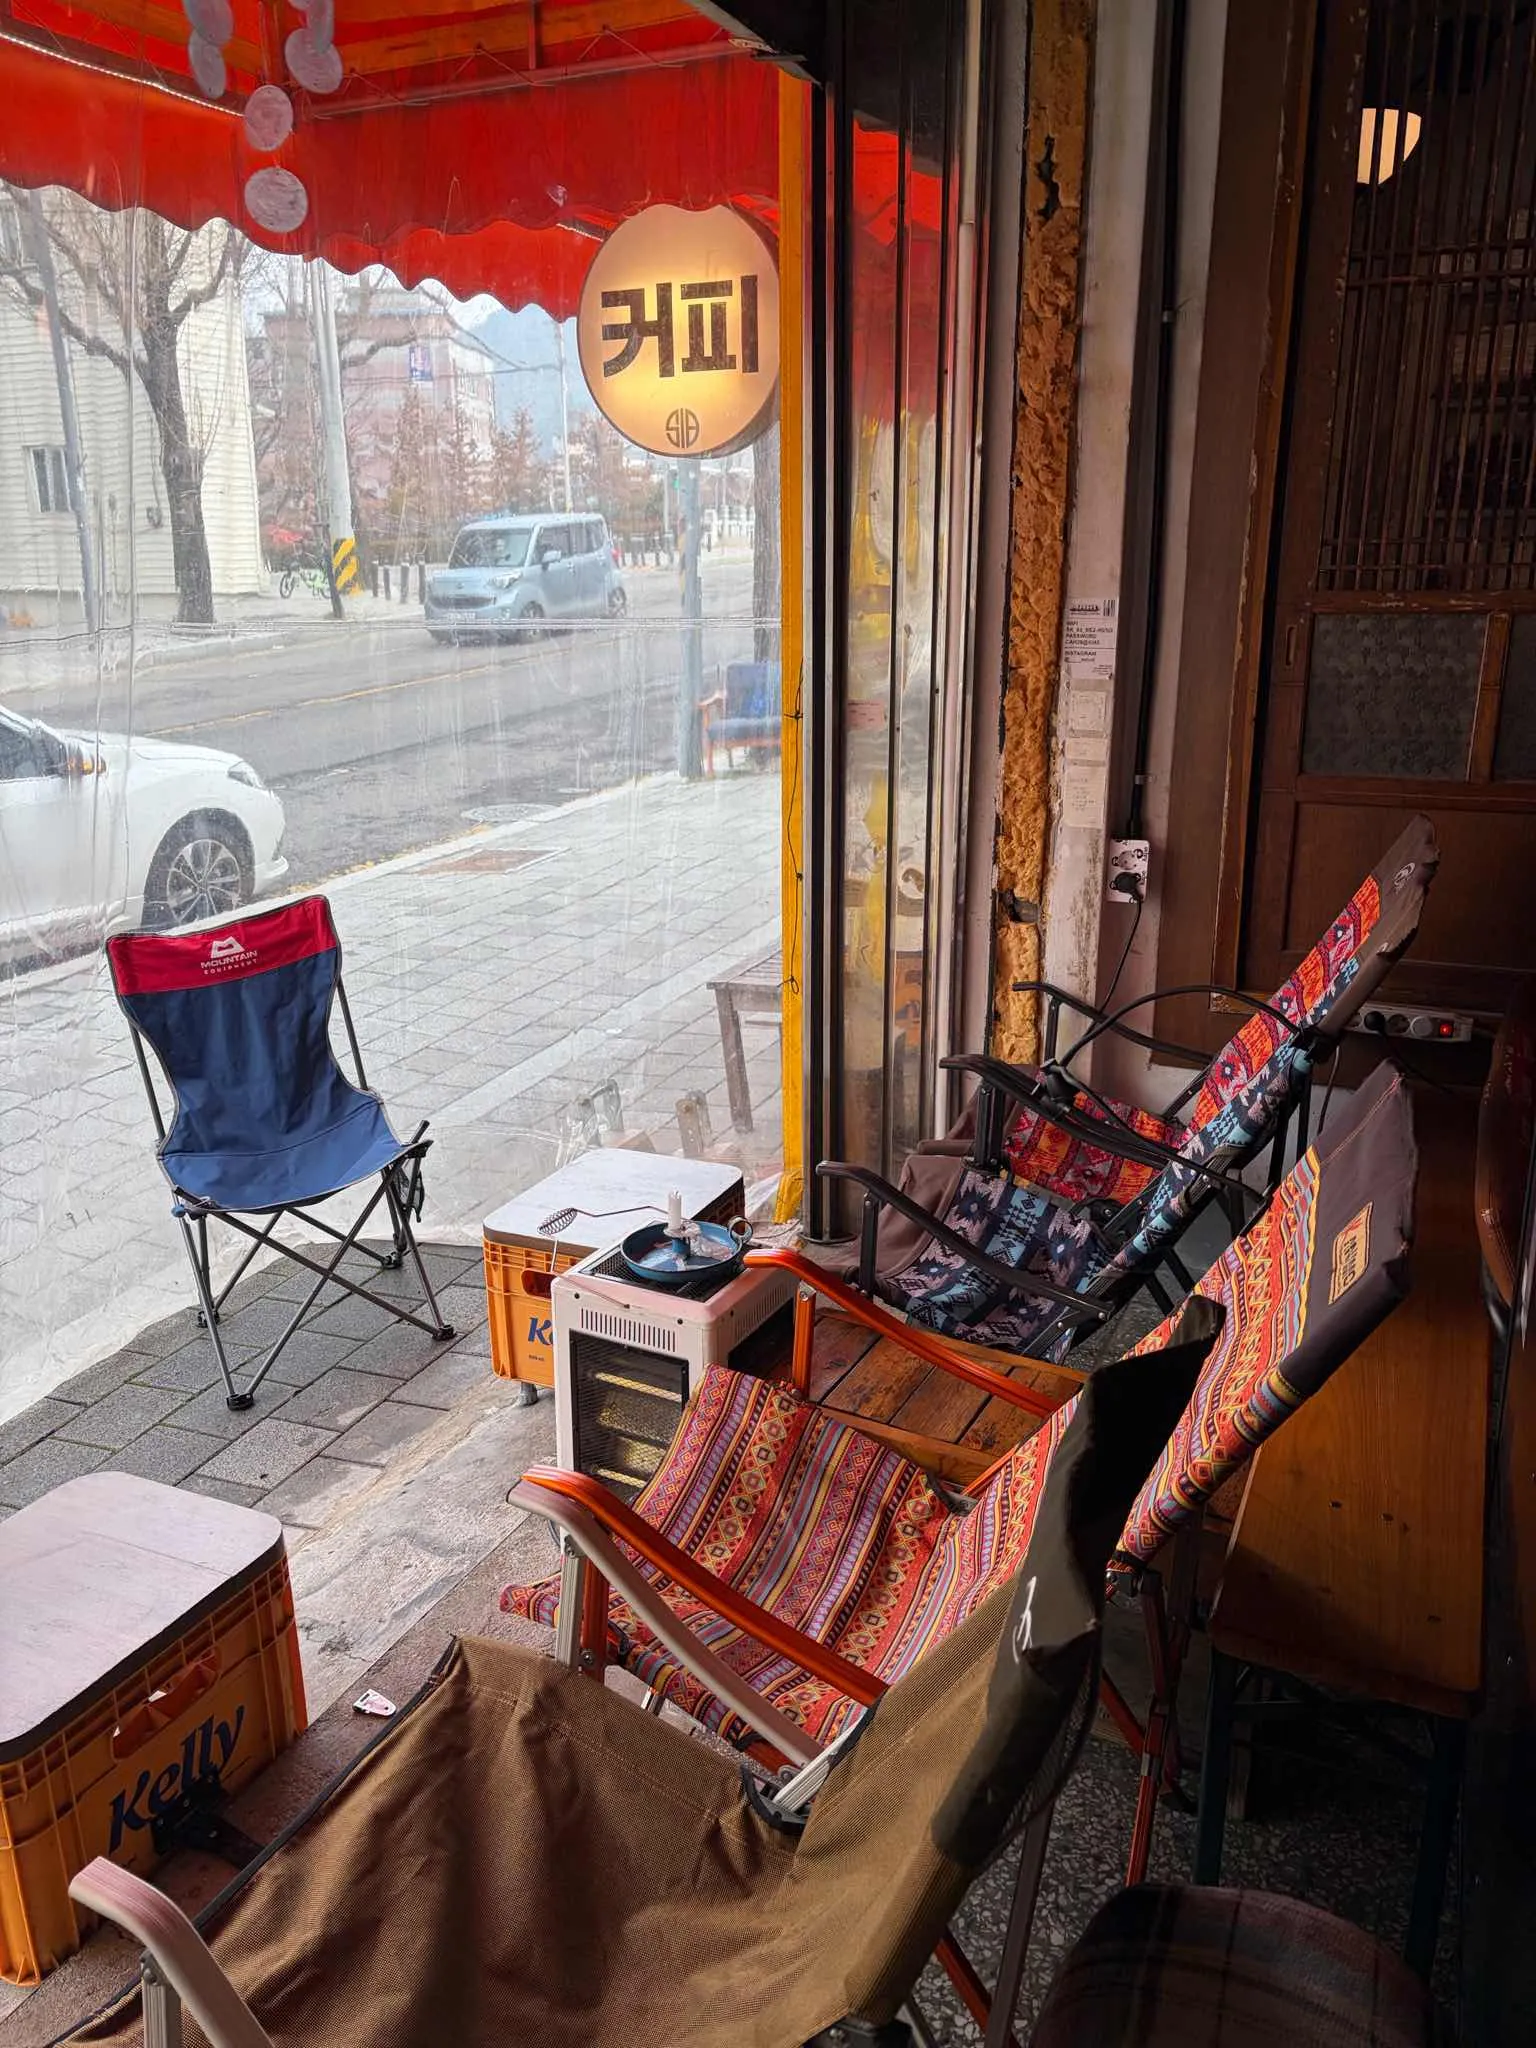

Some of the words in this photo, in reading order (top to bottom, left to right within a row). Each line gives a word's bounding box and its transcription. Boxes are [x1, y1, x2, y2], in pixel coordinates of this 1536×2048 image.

[601, 274, 760, 378] 커피
[200, 950, 258, 969] MOUNTAIN
[203, 958, 257, 975] EQUIPMENT
[109, 1704, 246, 1855] Kelly
